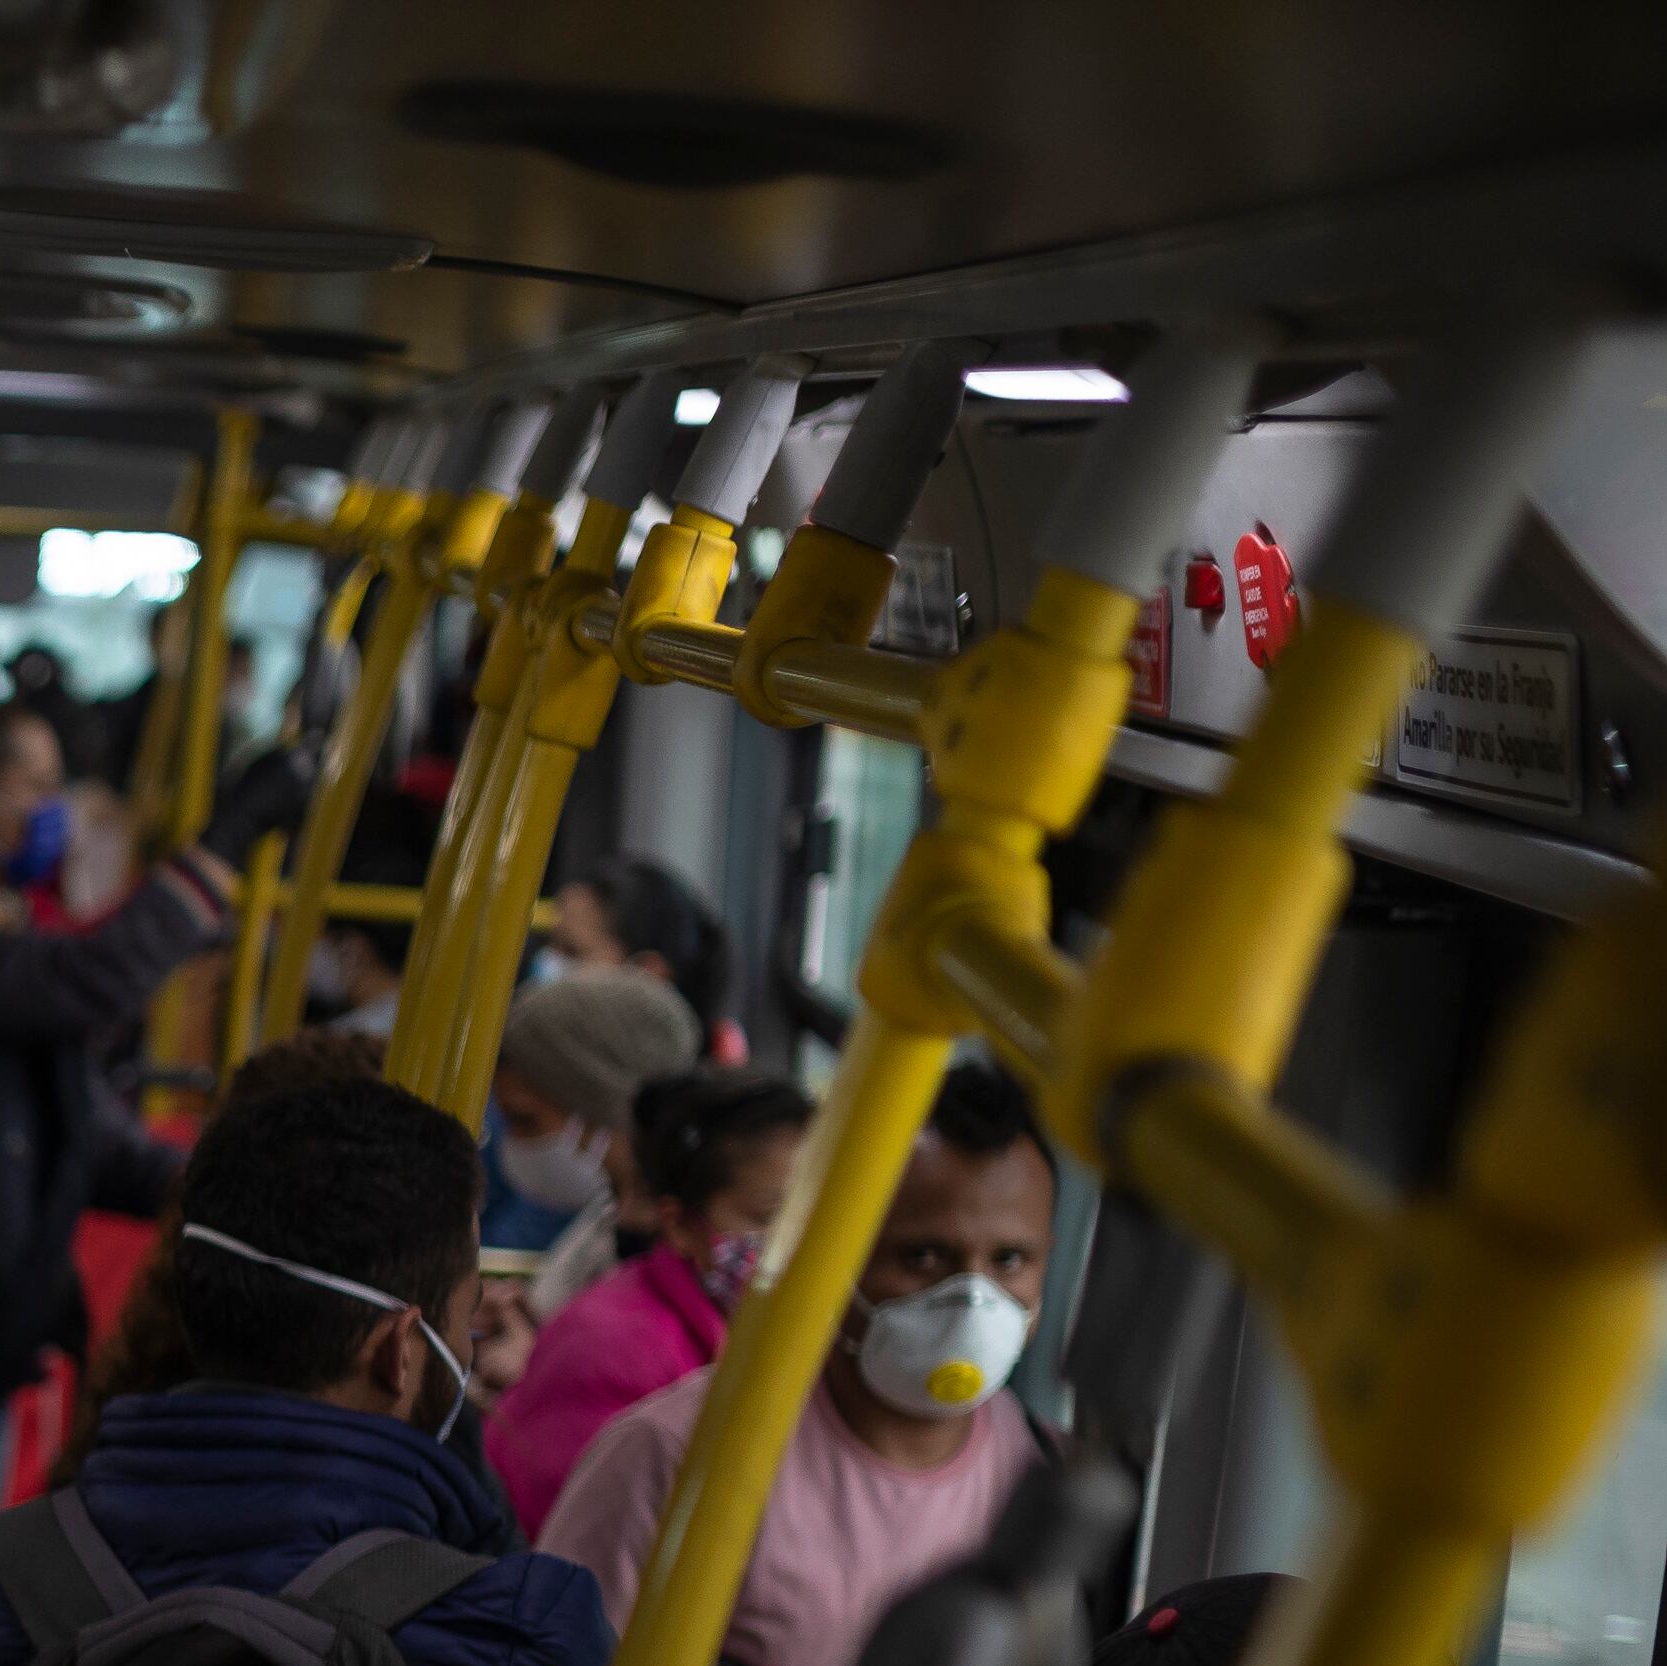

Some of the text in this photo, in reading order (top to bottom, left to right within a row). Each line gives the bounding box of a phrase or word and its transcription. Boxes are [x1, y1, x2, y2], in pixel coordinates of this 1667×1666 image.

[1429, 651, 1475, 700] Pararse
[1477, 671, 1493, 701] en
[1495, 659, 1510, 704] la
[1512, 661, 1556, 720] Franja
[1403, 704, 1453, 753] Amarilla
[1455, 726, 1478, 767] por
[1479, 731, 1495, 763] su
